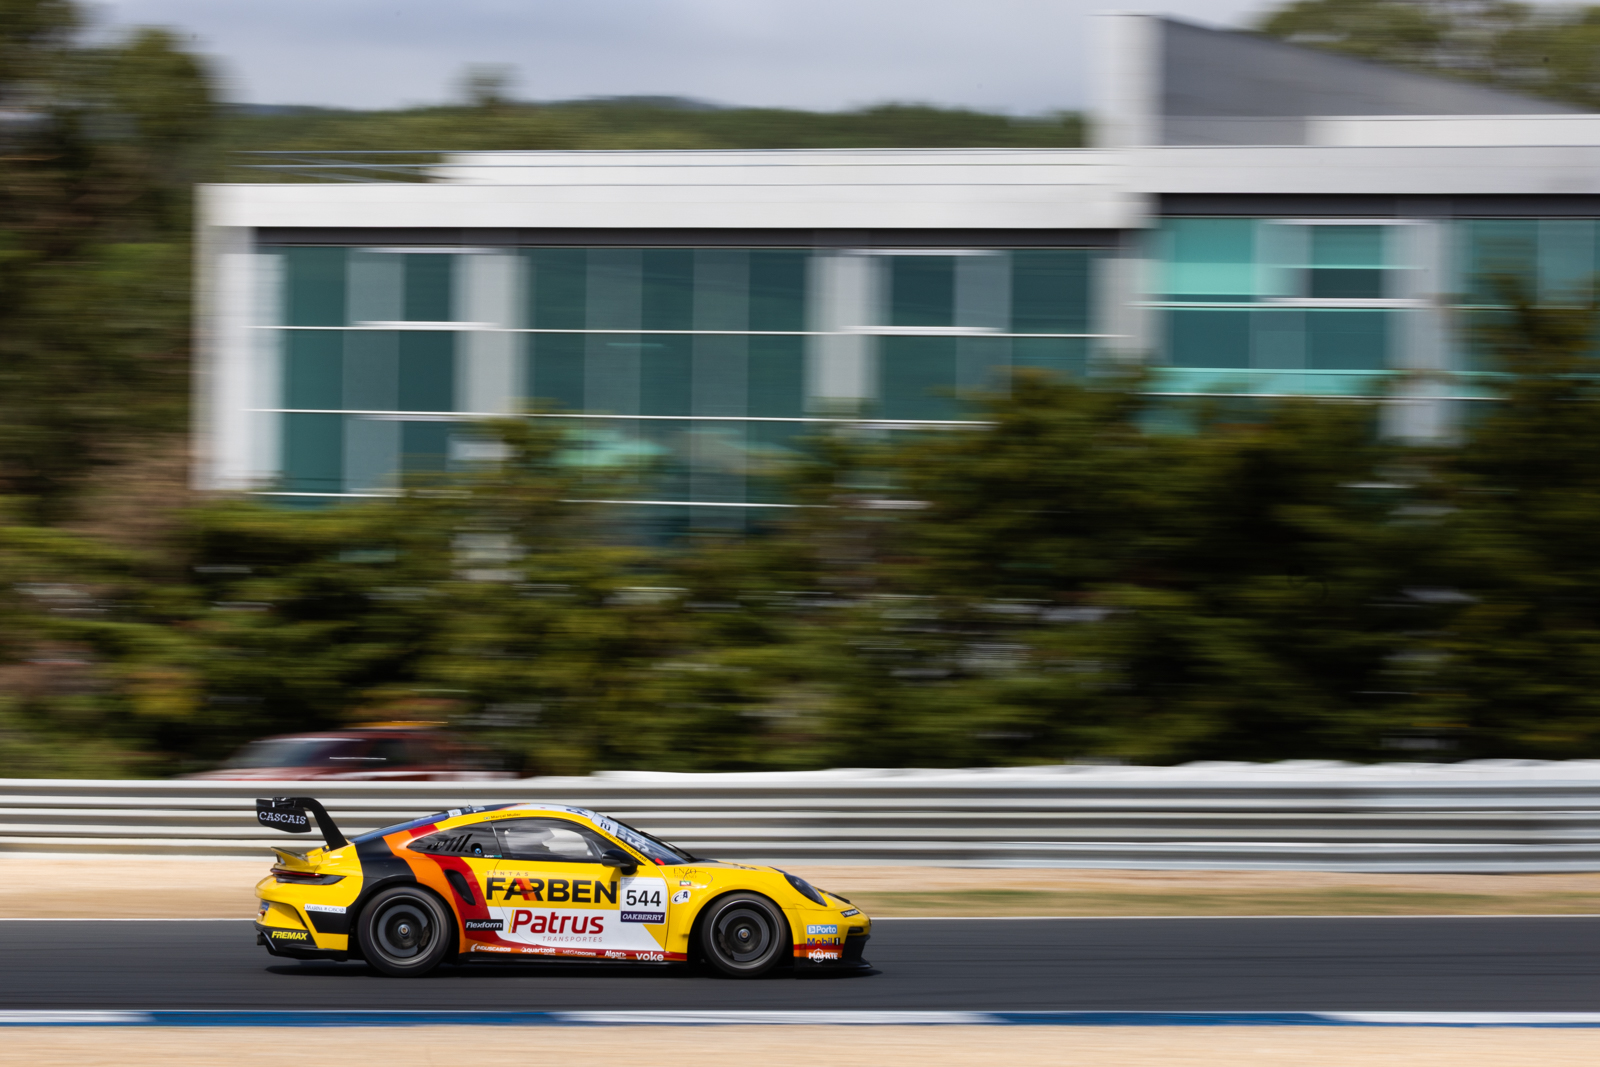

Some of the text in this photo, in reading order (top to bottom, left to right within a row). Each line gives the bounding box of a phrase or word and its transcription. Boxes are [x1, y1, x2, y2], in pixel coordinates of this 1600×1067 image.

[259, 811, 306, 825] CASCAIS
[486, 877, 617, 904] FARBEN
[626, 889, 662, 907] 544
[511, 910, 604, 934] Patrus
[622, 913, 664, 921] OAKBERRY
[465, 921, 503, 929] Flexform
[816, 925, 837, 934] Porto
[271, 931, 308, 941] FREMAX
[807, 938, 832, 946] Mobil
[526, 947, 556, 955] quartzolit
[635, 951, 664, 962] voke
